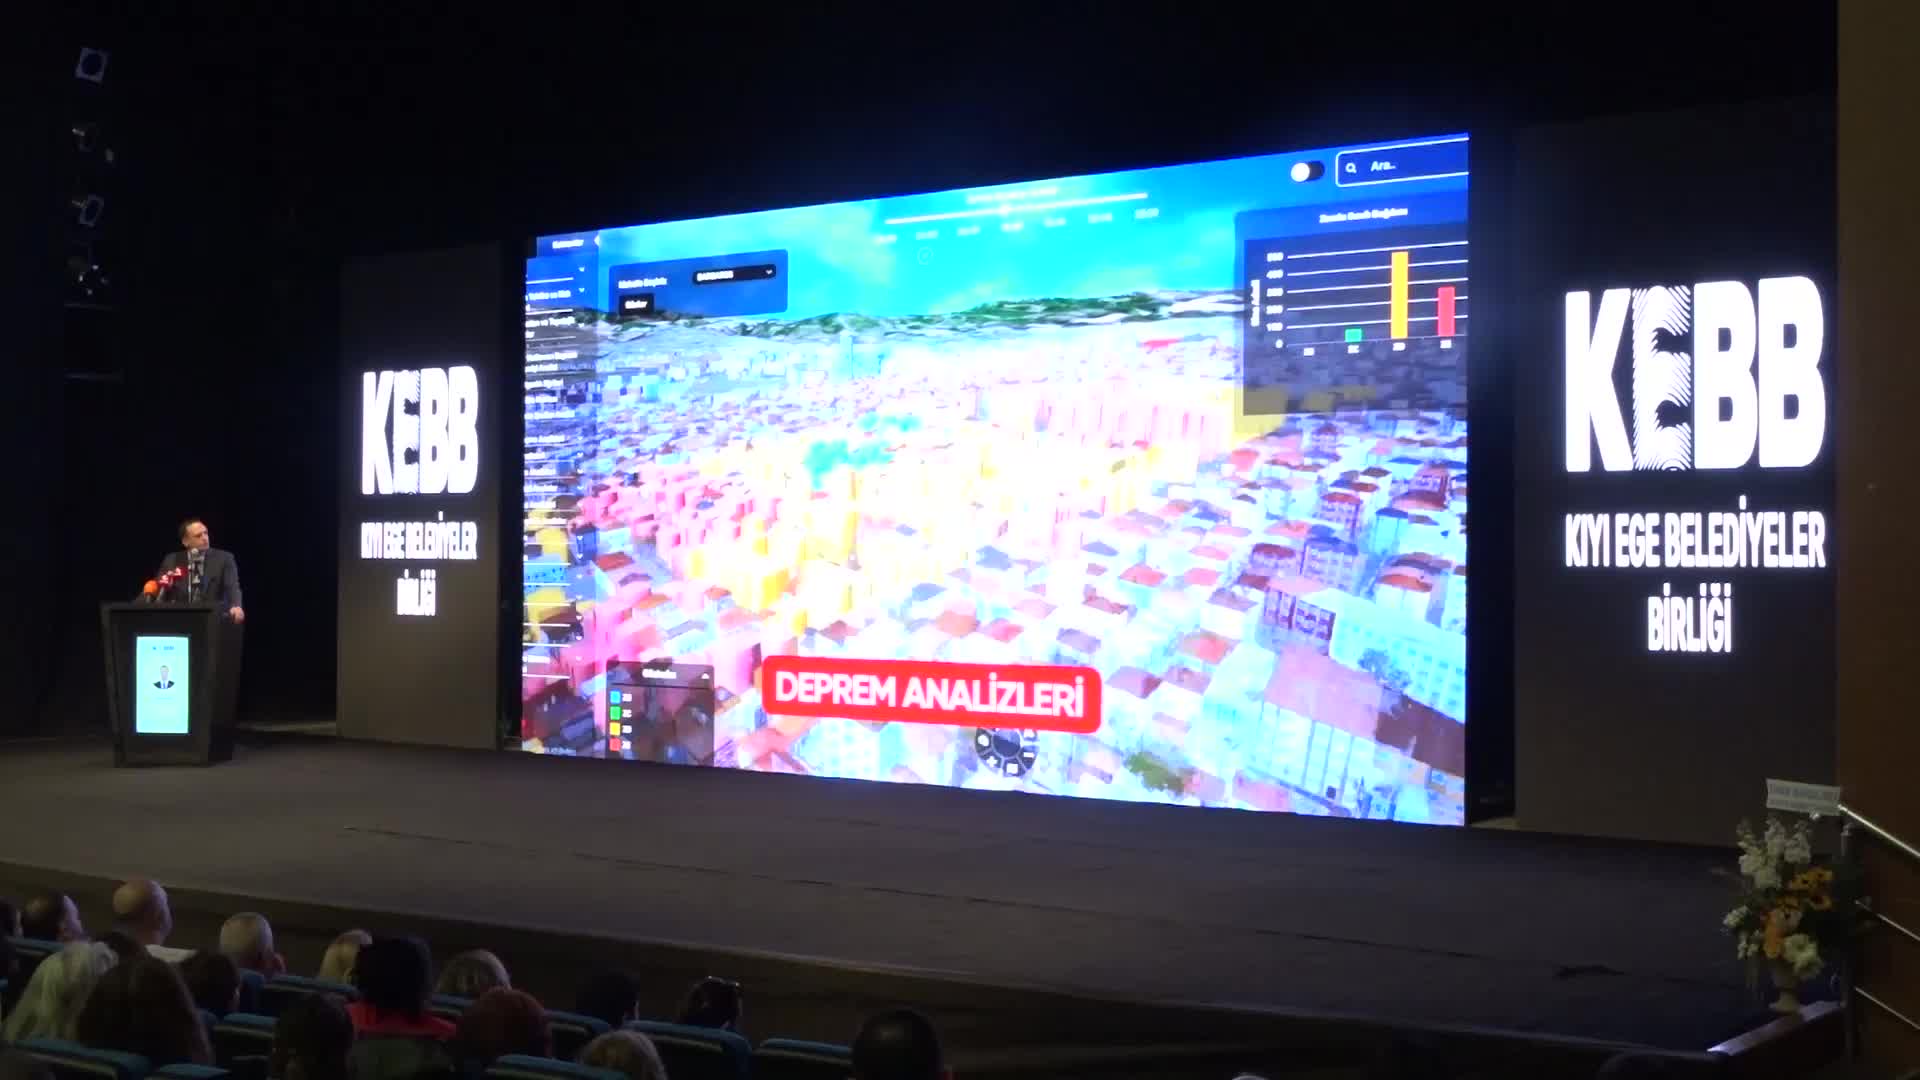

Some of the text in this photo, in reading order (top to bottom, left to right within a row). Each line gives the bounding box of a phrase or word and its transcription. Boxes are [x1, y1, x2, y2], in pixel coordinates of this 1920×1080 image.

[1565, 276, 1826, 472] KEBB
[362, 366, 479, 494] KEBB
[1565, 495, 1826, 568] KIYI EGE BELEDİYELER
[1647, 582, 1732, 653] BİRLİĞİ
[775, 671, 1085, 718] DEPREM ANALİZLERİ
